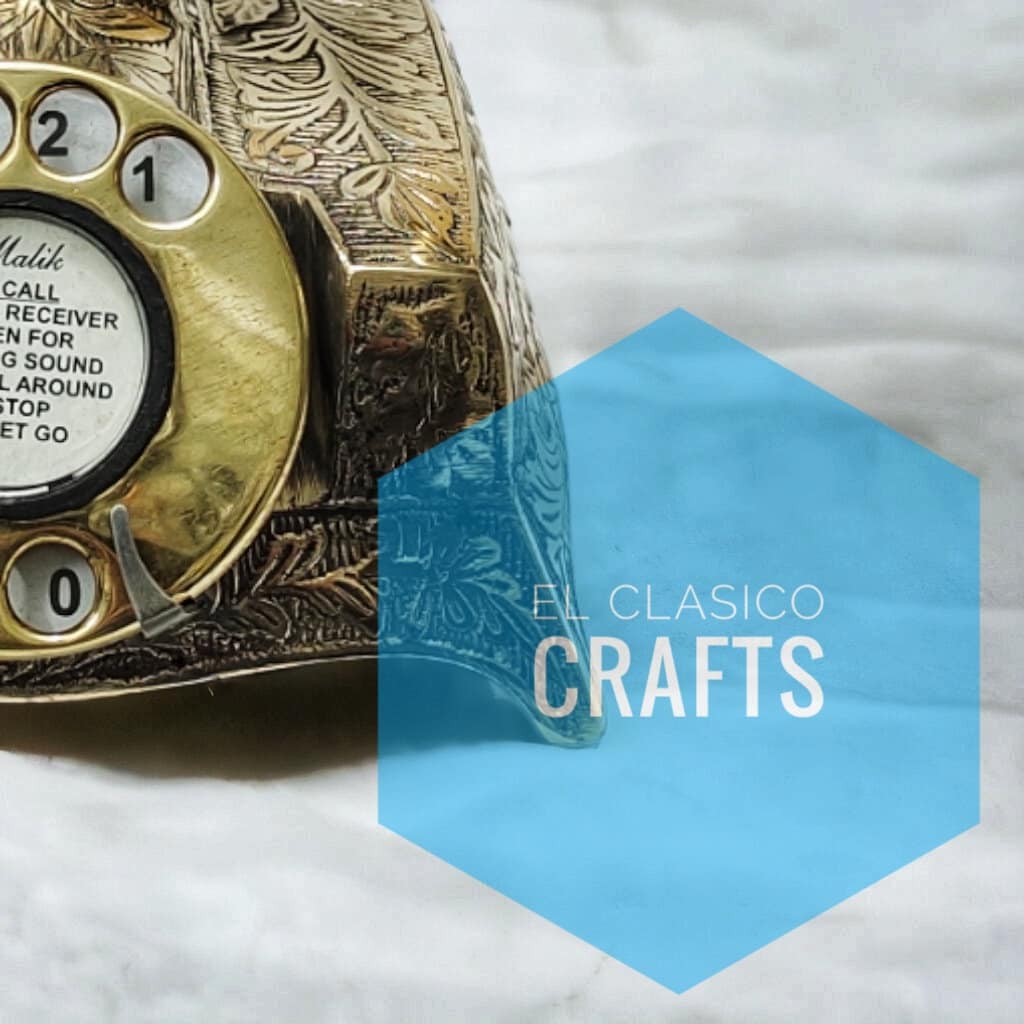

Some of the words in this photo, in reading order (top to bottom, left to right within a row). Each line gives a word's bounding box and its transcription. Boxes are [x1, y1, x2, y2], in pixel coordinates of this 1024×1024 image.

[36, 110, 68, 157] 2
[131, 156, 156, 203] 1
[2, 280, 60, 302] CALL
[5, 304, 119, 330] RECEIVER
[28, 329, 74, 349] FOR
[24, 352, 104, 375] SOUND
[16, 376, 113, 400] AROUND
[34, 425, 69, 443] GO
[49, 568, 81, 615] 0
